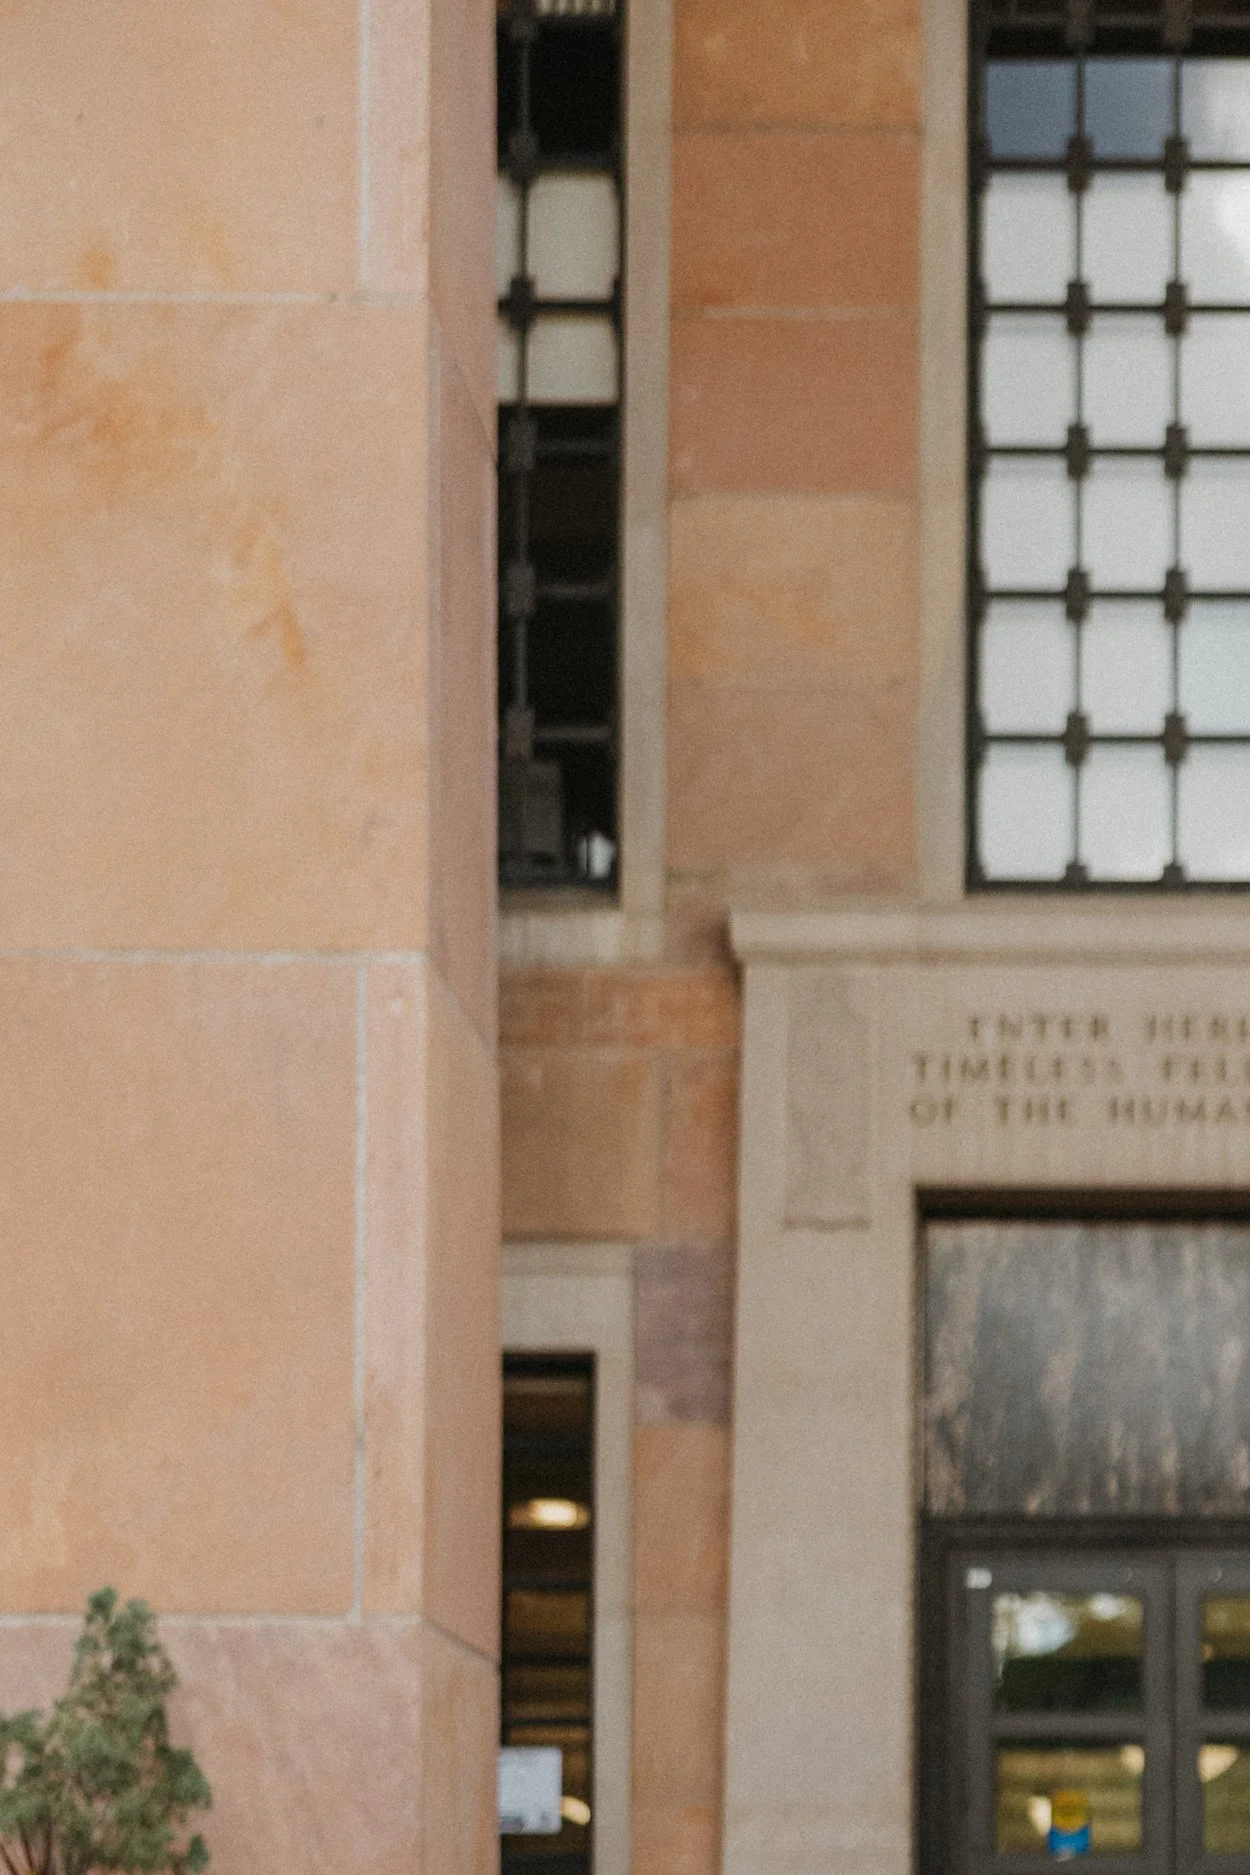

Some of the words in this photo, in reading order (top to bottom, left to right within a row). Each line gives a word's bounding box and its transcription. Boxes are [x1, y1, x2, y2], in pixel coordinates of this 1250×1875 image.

[966, 1012, 1110, 1043] ENTER
[911, 1052, 1124, 1084] TIMELESS
[907, 1096, 956, 1128] OF
[994, 1096, 1074, 1127] THE
